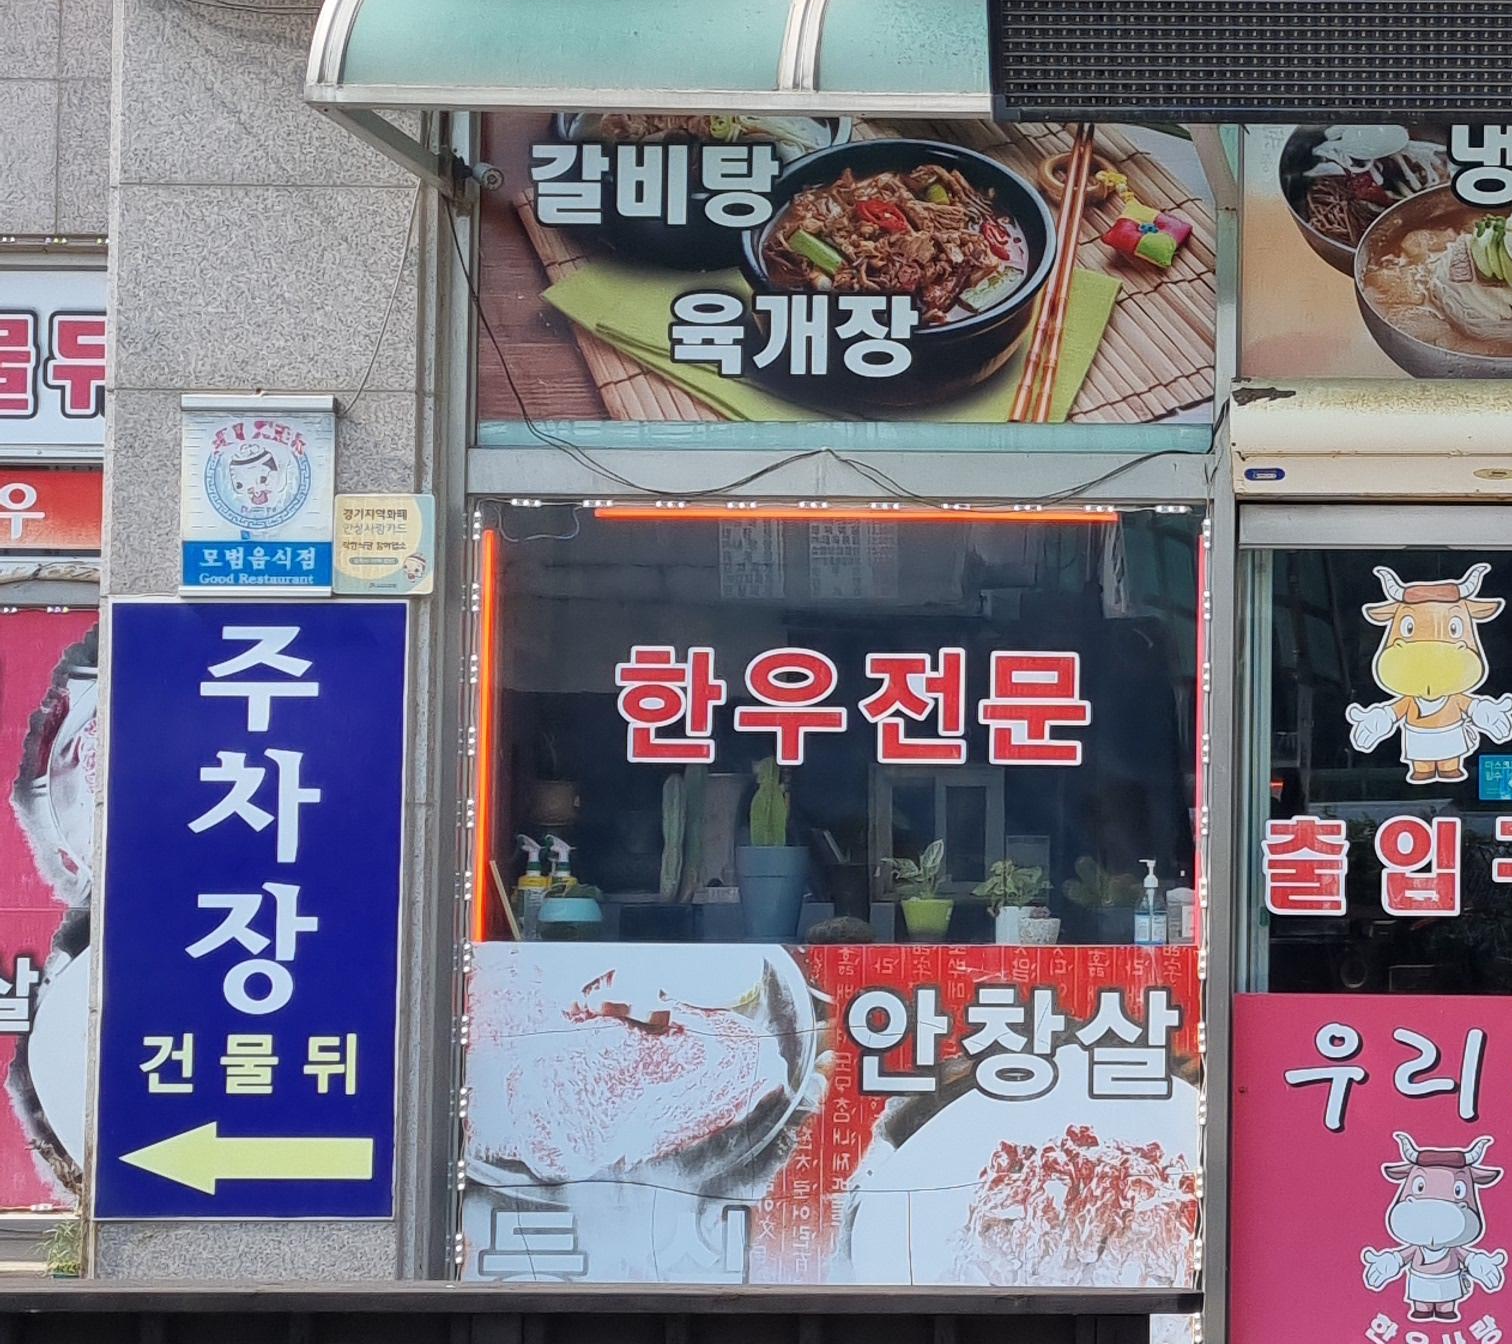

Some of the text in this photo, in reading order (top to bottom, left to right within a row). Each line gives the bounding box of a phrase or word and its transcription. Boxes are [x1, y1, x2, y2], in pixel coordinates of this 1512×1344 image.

[529, 143, 782, 230] 갈비탕
[669, 290, 922, 380] 육개장
[199, 546, 317, 571] 모범음식점
[199, 573, 315, 585] Good Restaurant
[615, 644, 1092, 766] 한우전문
[186, 624, 322, 1016] 주차장
[846, 985, 1184, 1102] 안창살
